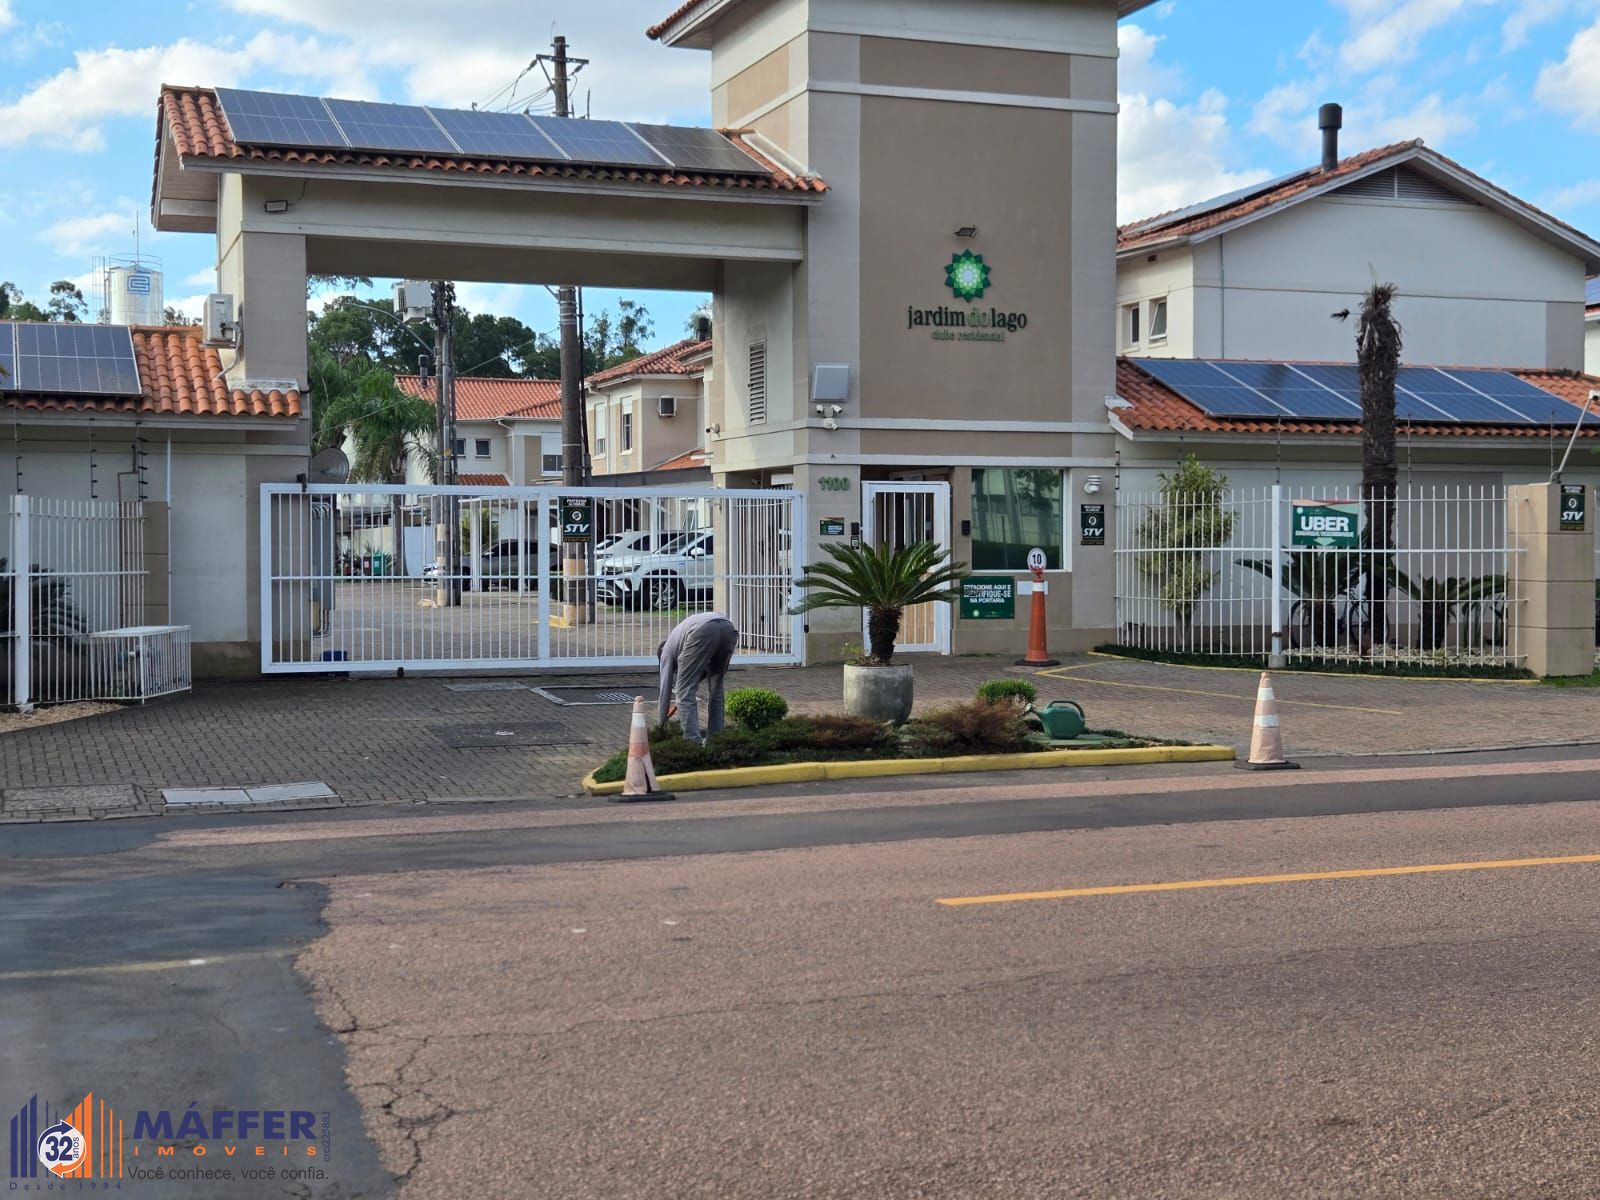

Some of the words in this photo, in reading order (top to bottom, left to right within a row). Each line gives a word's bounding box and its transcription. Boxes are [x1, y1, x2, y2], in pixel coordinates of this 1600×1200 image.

[1561, 511, 1583, 520] STV
[564, 523, 590, 533] STV
[1301, 516, 1349, 532] UBER
[1083, 528, 1104, 536] STV
[1032, 553, 1042, 565] 10
